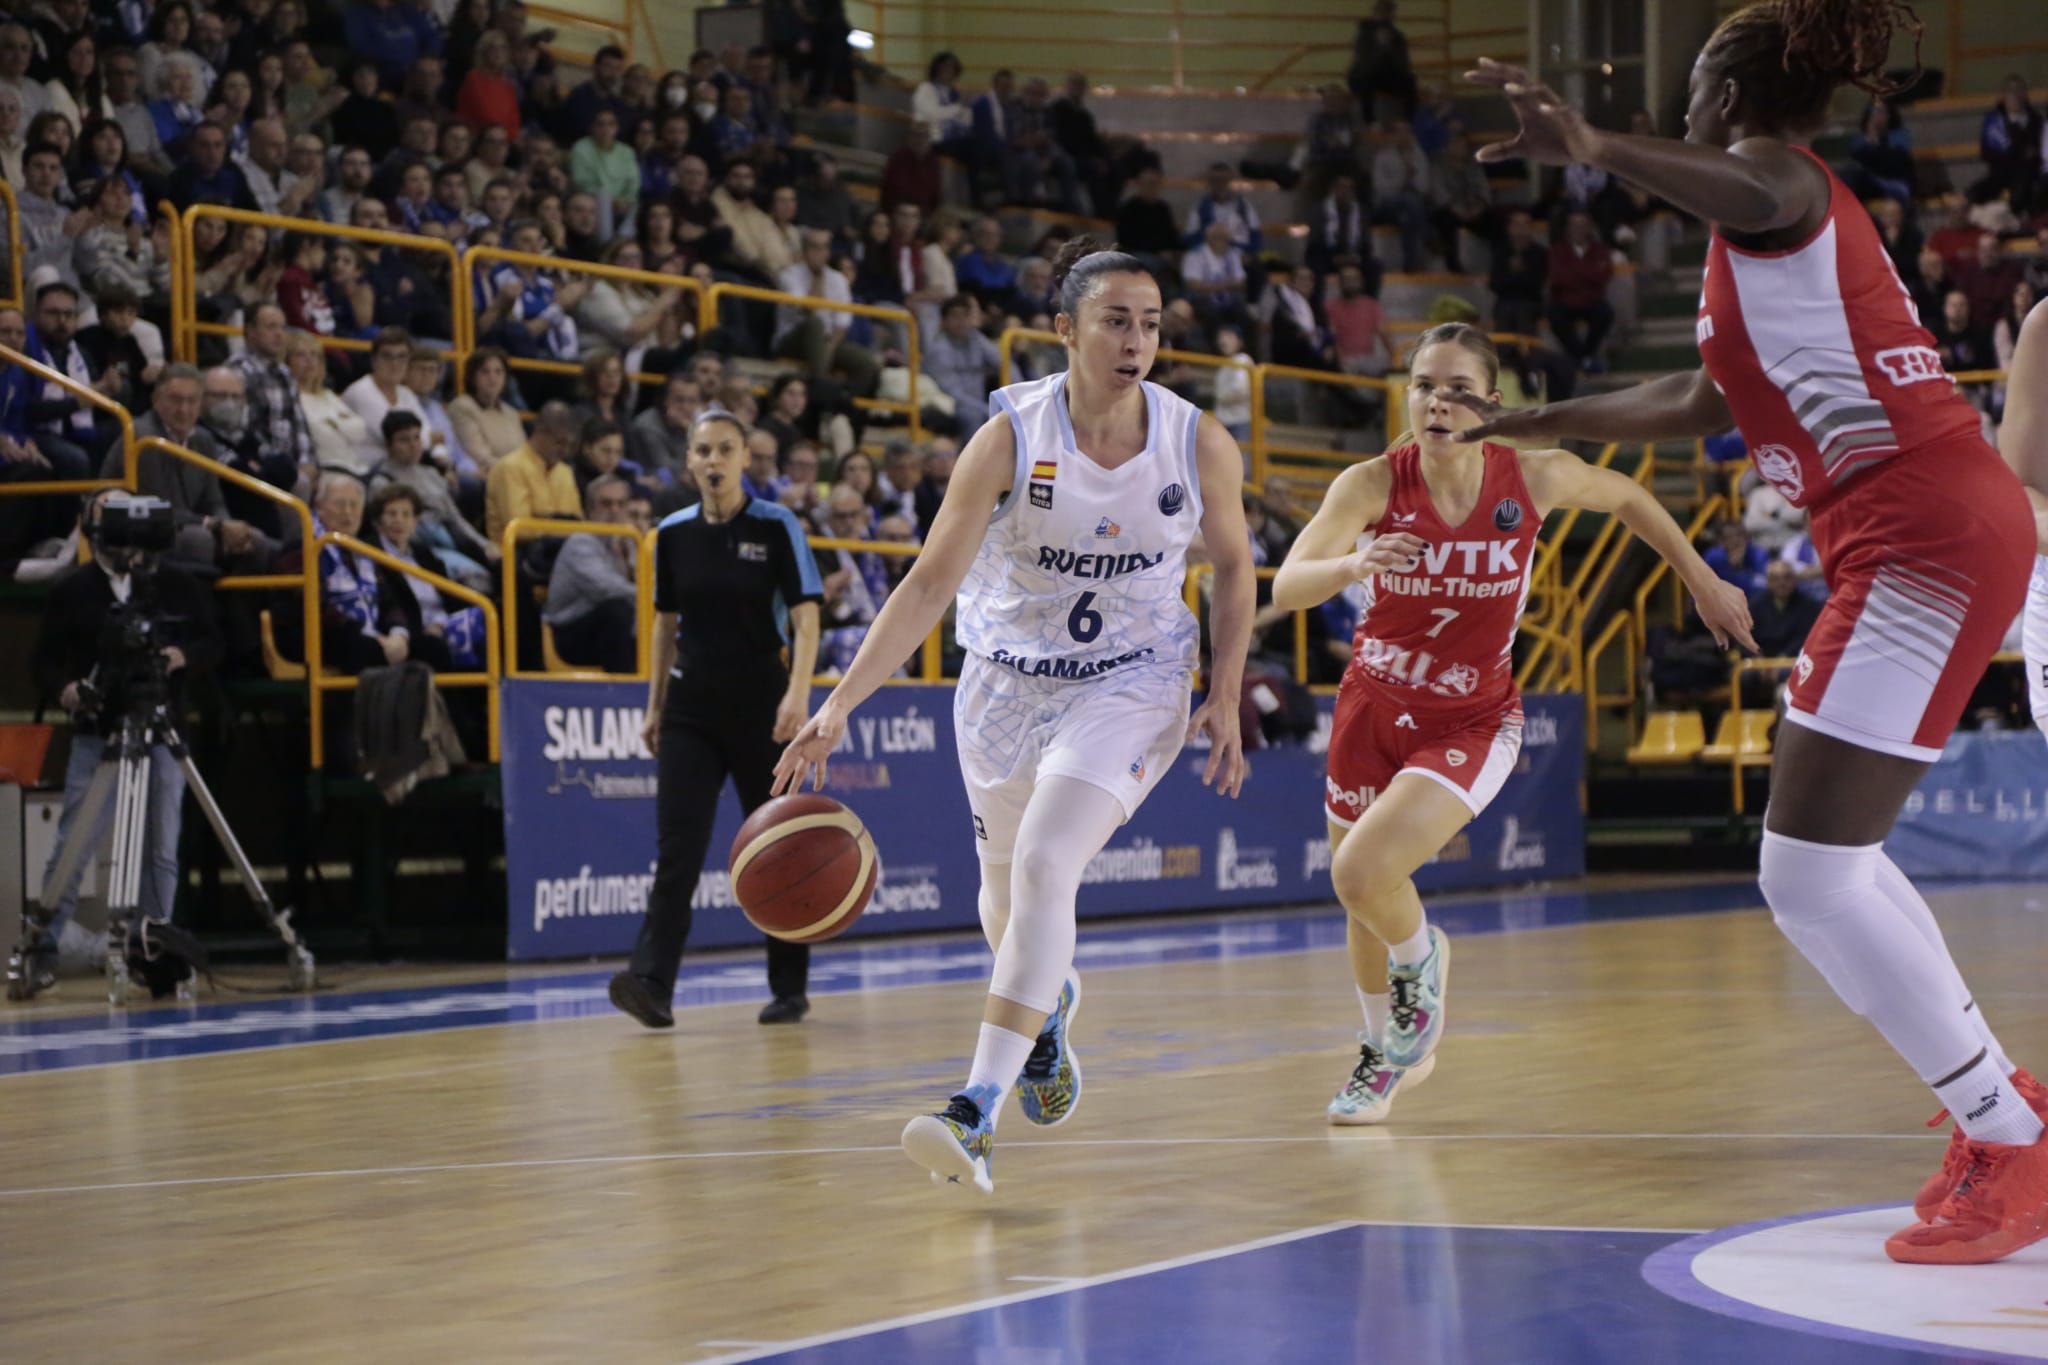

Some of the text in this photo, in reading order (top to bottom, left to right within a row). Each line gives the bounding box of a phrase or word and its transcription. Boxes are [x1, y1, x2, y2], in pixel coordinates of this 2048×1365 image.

[1067, 590, 1103, 643] 6
[1426, 608, 1461, 638] 7
[880, 705, 935, 752] LEÓN
